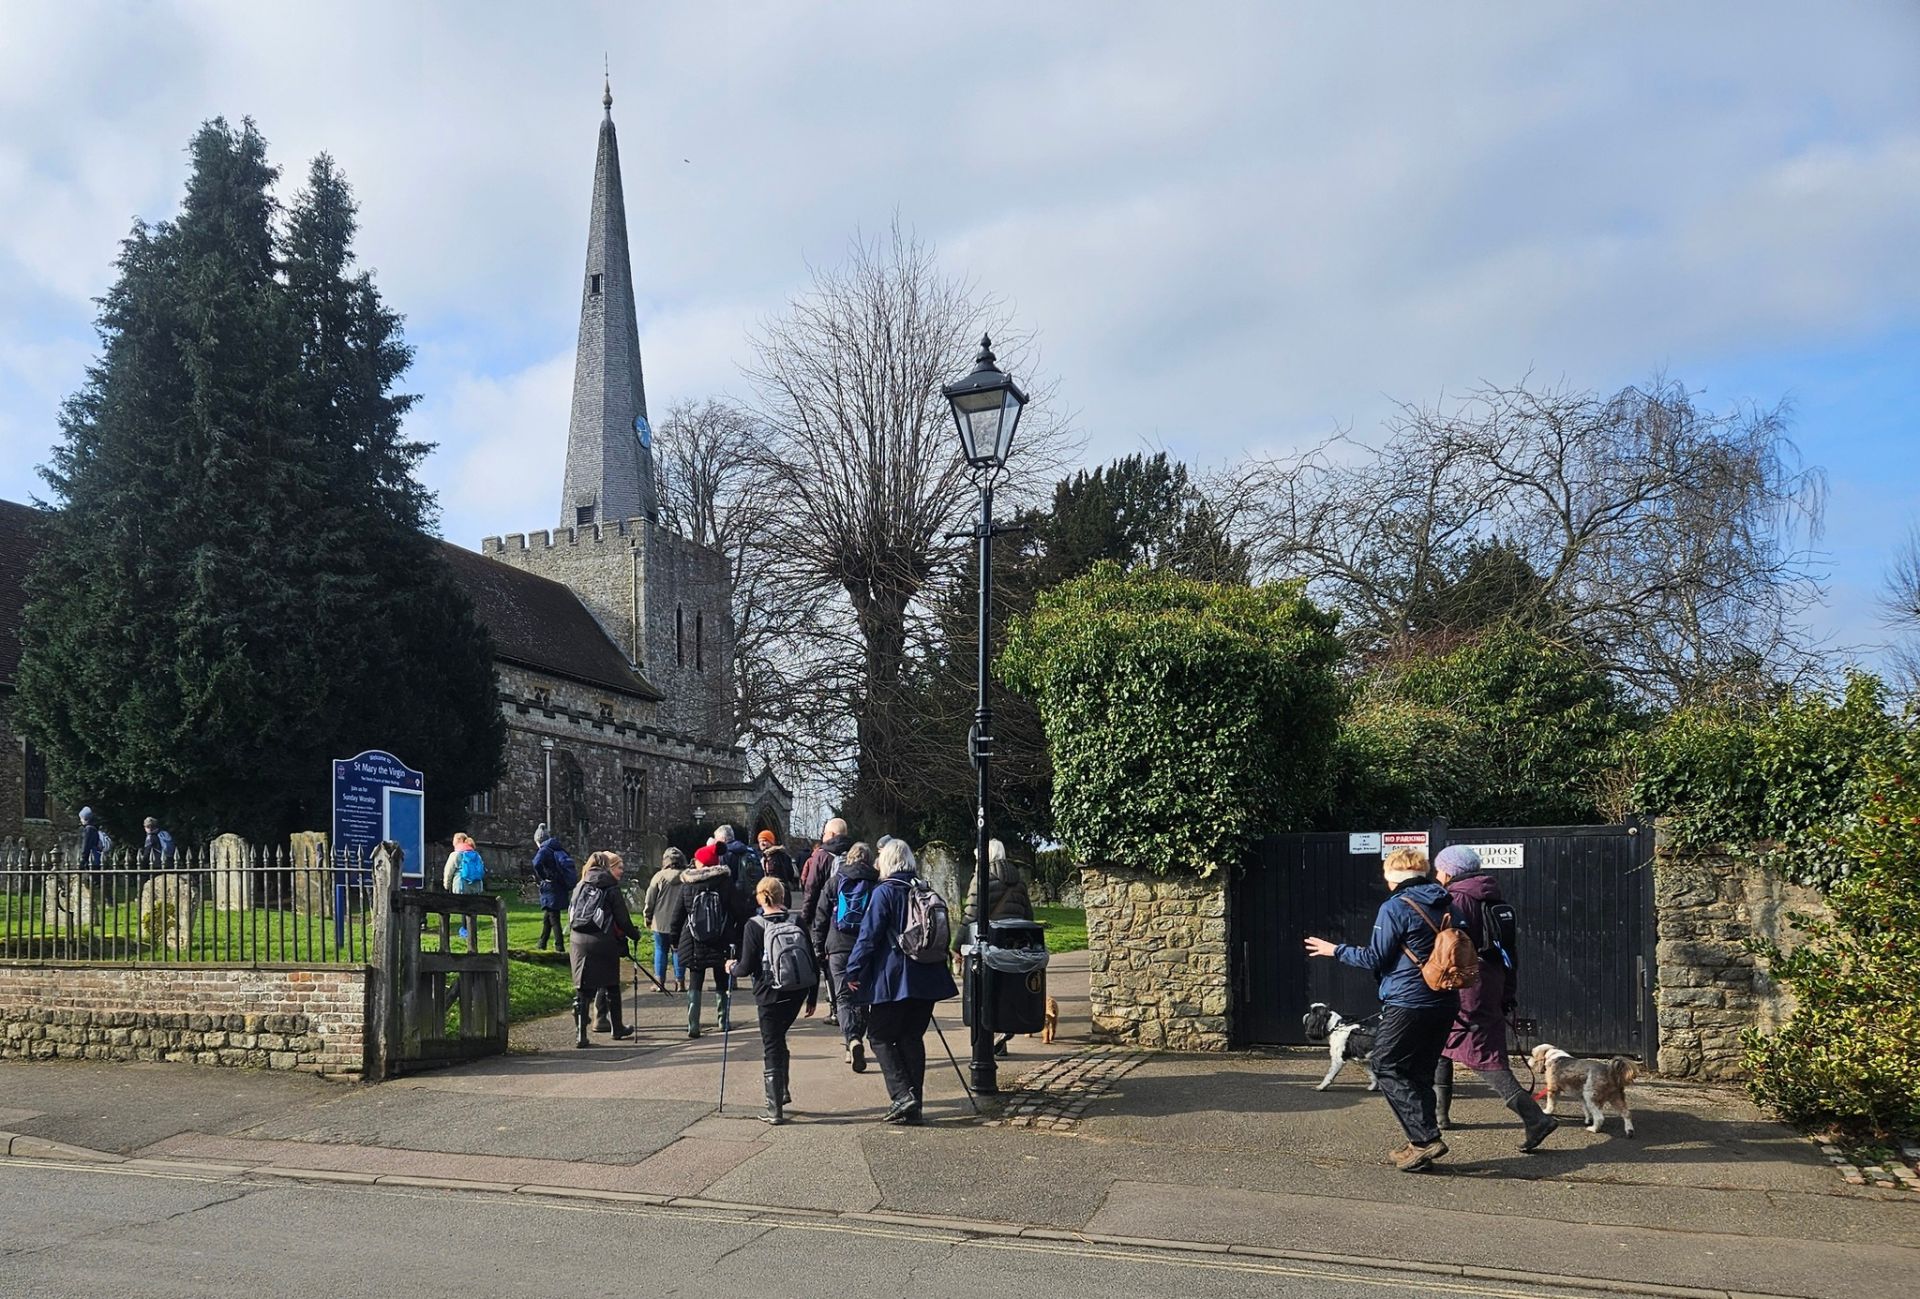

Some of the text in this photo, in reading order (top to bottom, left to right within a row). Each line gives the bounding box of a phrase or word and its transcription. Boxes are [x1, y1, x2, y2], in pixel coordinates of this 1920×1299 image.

[354, 762, 406, 779] St Mary the Virgin
[343, 793, 376, 804] Sunday Worship
